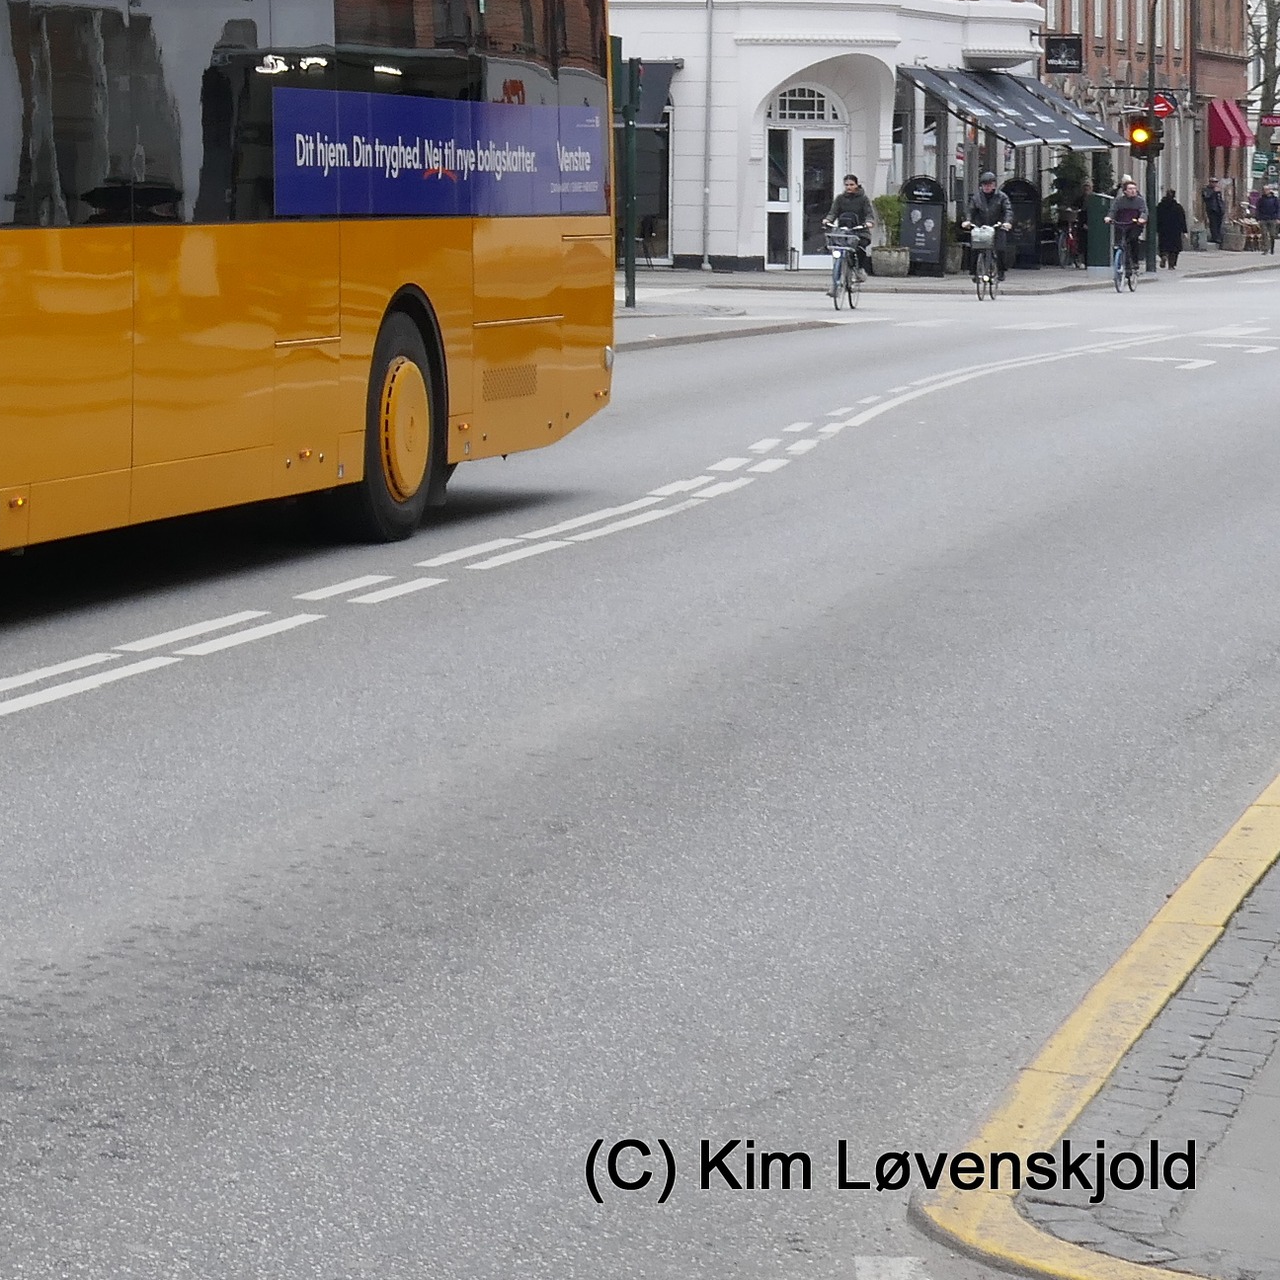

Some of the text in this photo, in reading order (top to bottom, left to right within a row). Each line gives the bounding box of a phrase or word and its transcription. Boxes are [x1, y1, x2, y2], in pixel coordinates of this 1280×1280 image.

[295, 132, 538, 181] Dit hjem. Din tryghed. Nej til nye boligskatter.
[556, 140, 592, 172] Venstre
